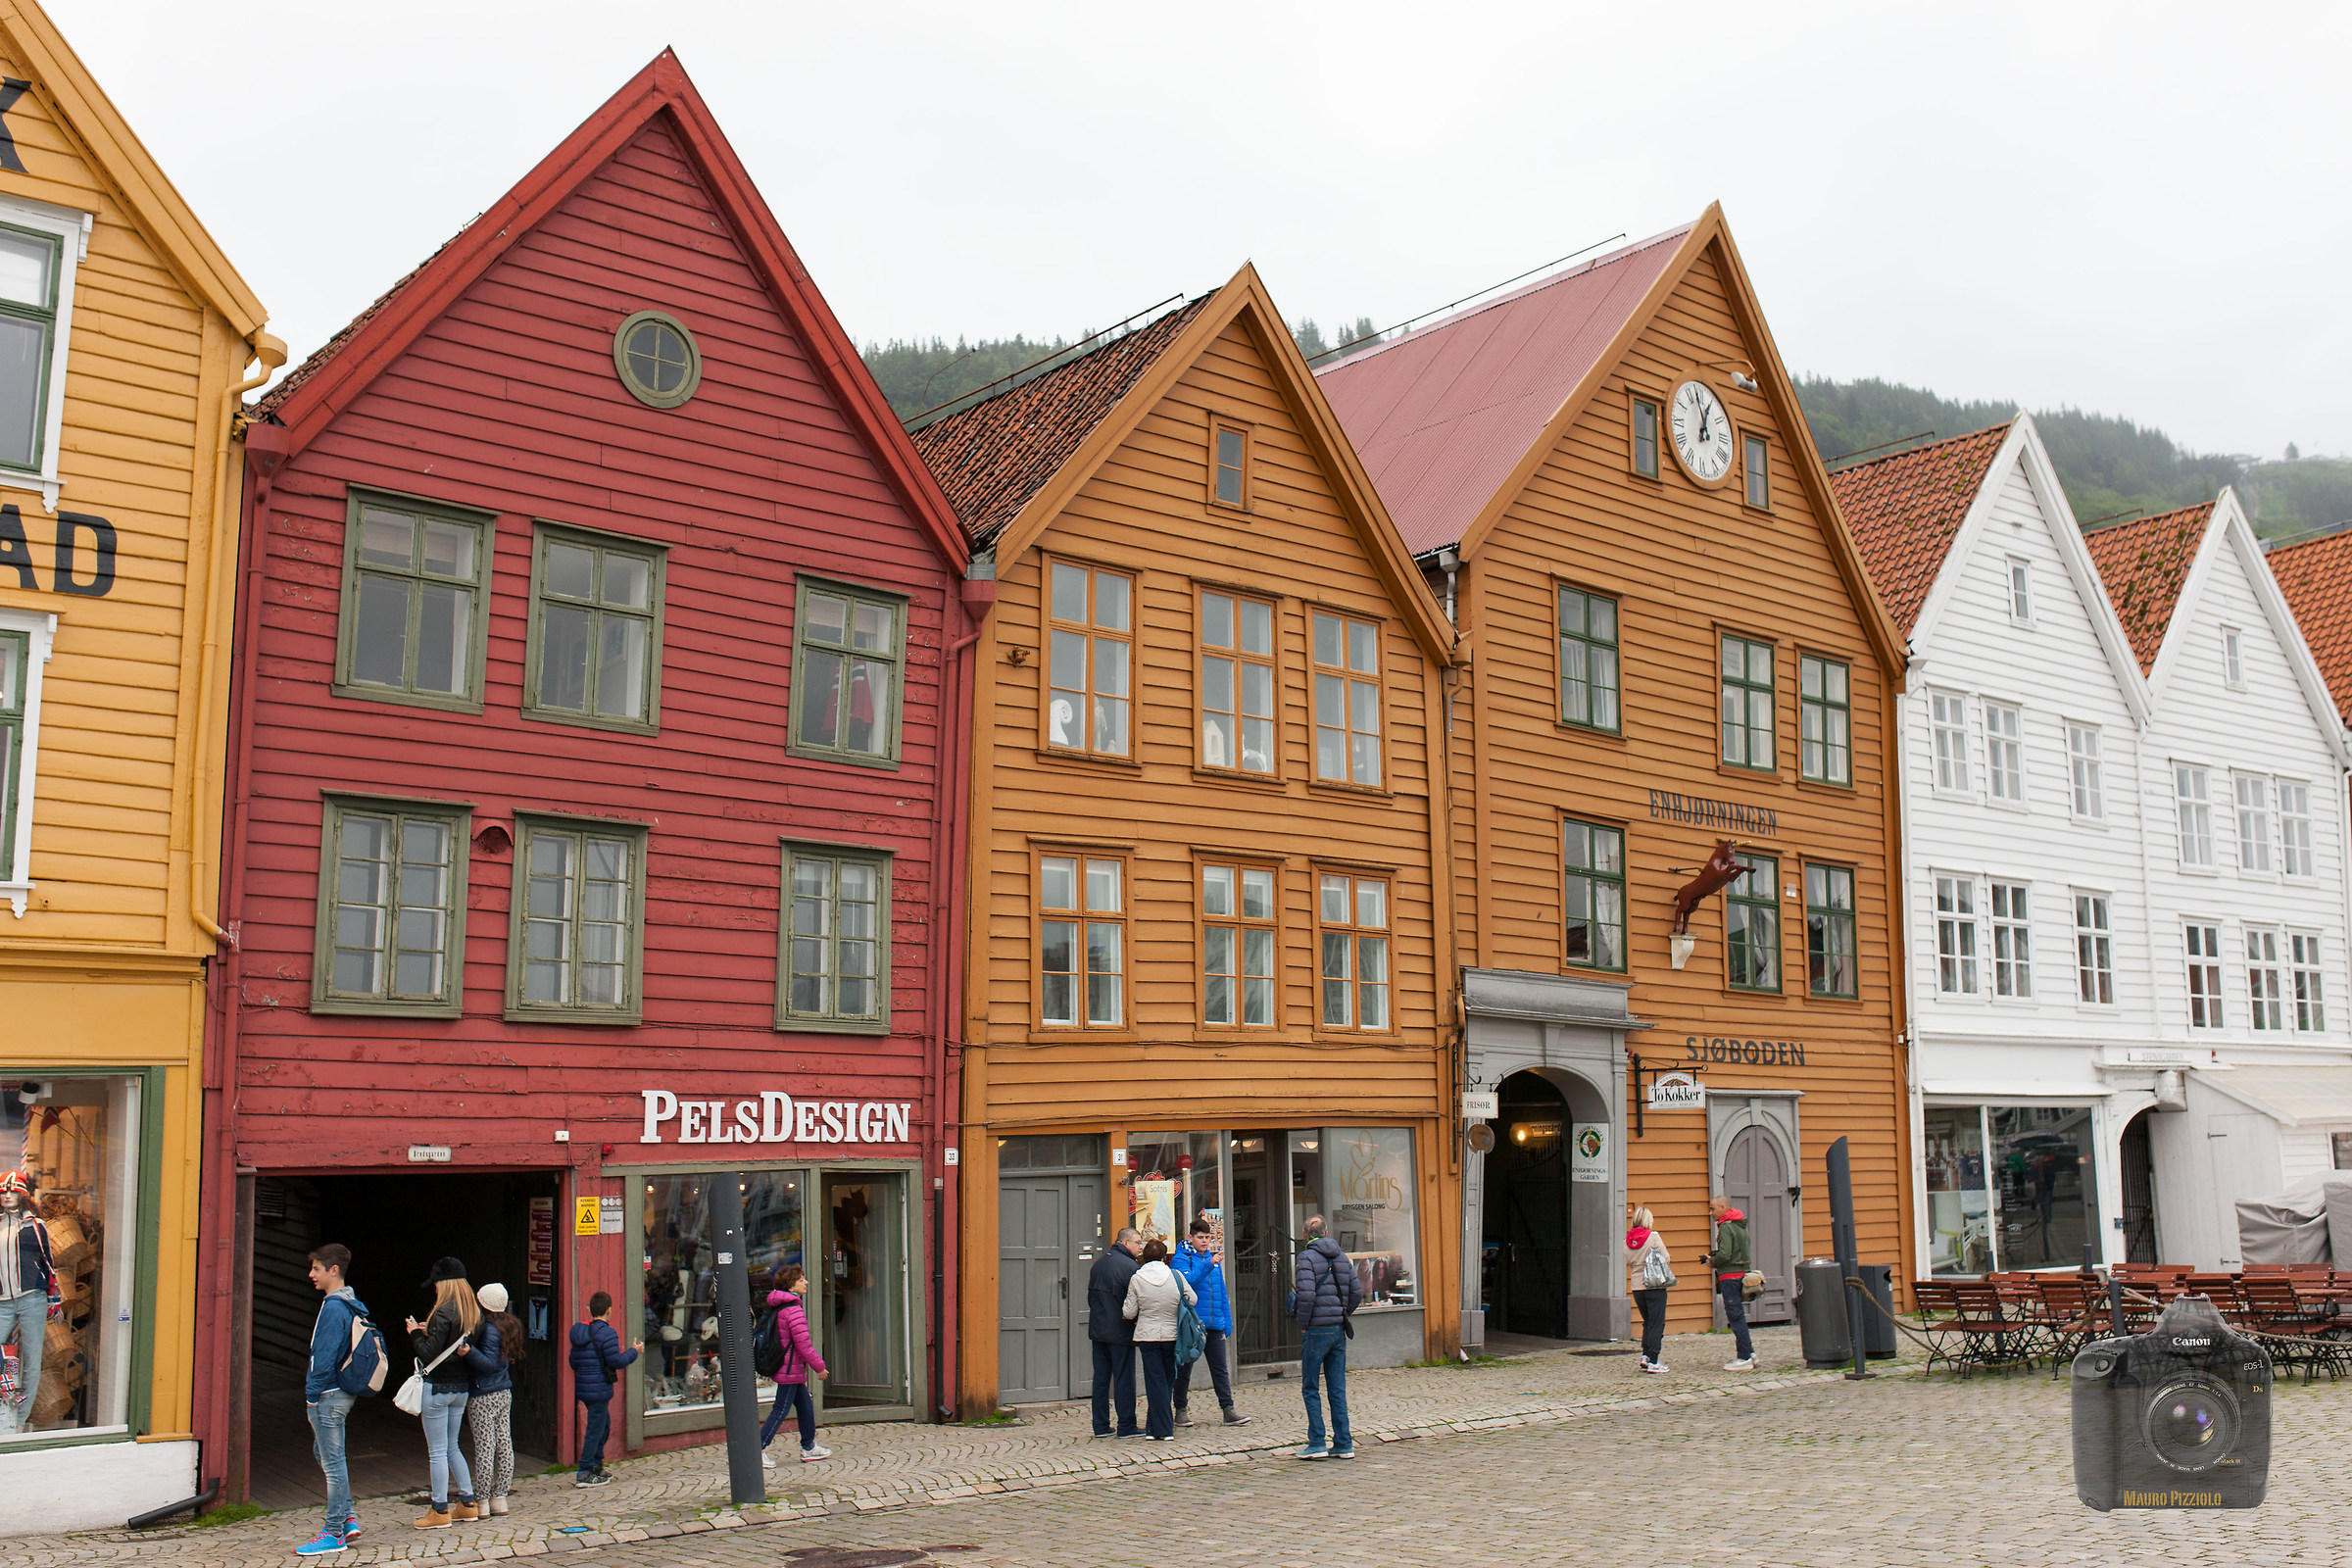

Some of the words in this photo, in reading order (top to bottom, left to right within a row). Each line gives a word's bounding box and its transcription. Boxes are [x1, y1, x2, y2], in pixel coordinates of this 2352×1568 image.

[1648, 789, 1777, 837] ENHJØRNINGEN
[1686, 1037, 1805, 1066] SJØBODEN
[639, 1090, 911, 1144] PELSDESIGN
[1651, 1088, 1664, 1102] To
[1665, 1087, 1701, 1102] Kokker
[1340, 1164, 1402, 1211] Martins
